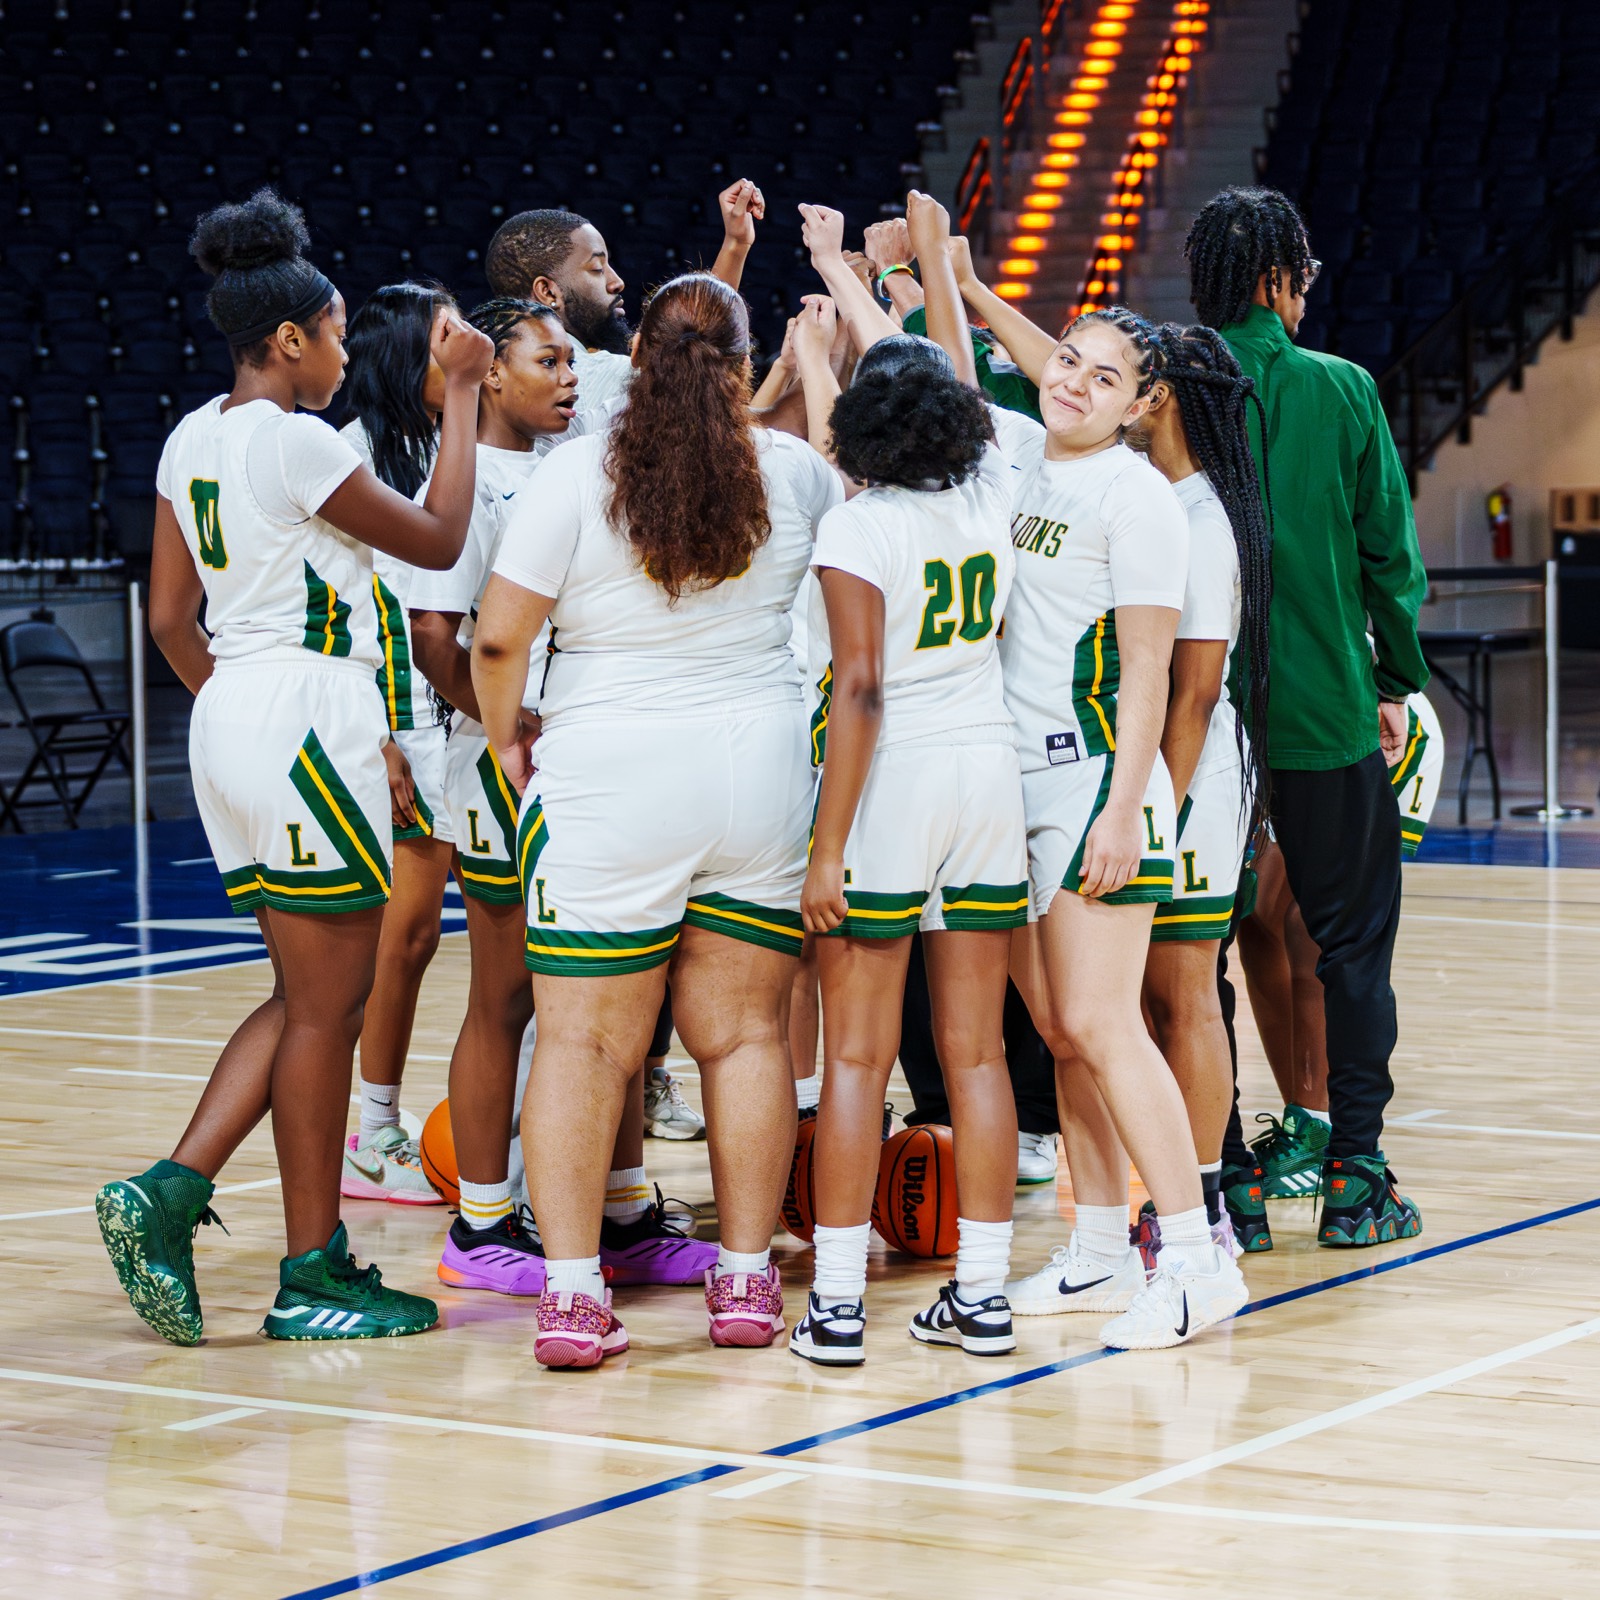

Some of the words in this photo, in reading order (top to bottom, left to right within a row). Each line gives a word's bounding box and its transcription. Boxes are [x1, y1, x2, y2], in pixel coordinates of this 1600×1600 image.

[914, 550, 997, 652] 20
[1054, 736, 1066, 747] M
[287, 823, 317, 866] L
[467, 808, 491, 854] L
[1143, 805, 1164, 852] L
[1181, 850, 1208, 894] L
[535, 878, 556, 924] L
[902, 1154, 928, 1241] Wilson
[837, 1306, 857, 1316] NIKE
[989, 1298, 1008, 1308] NIKE
